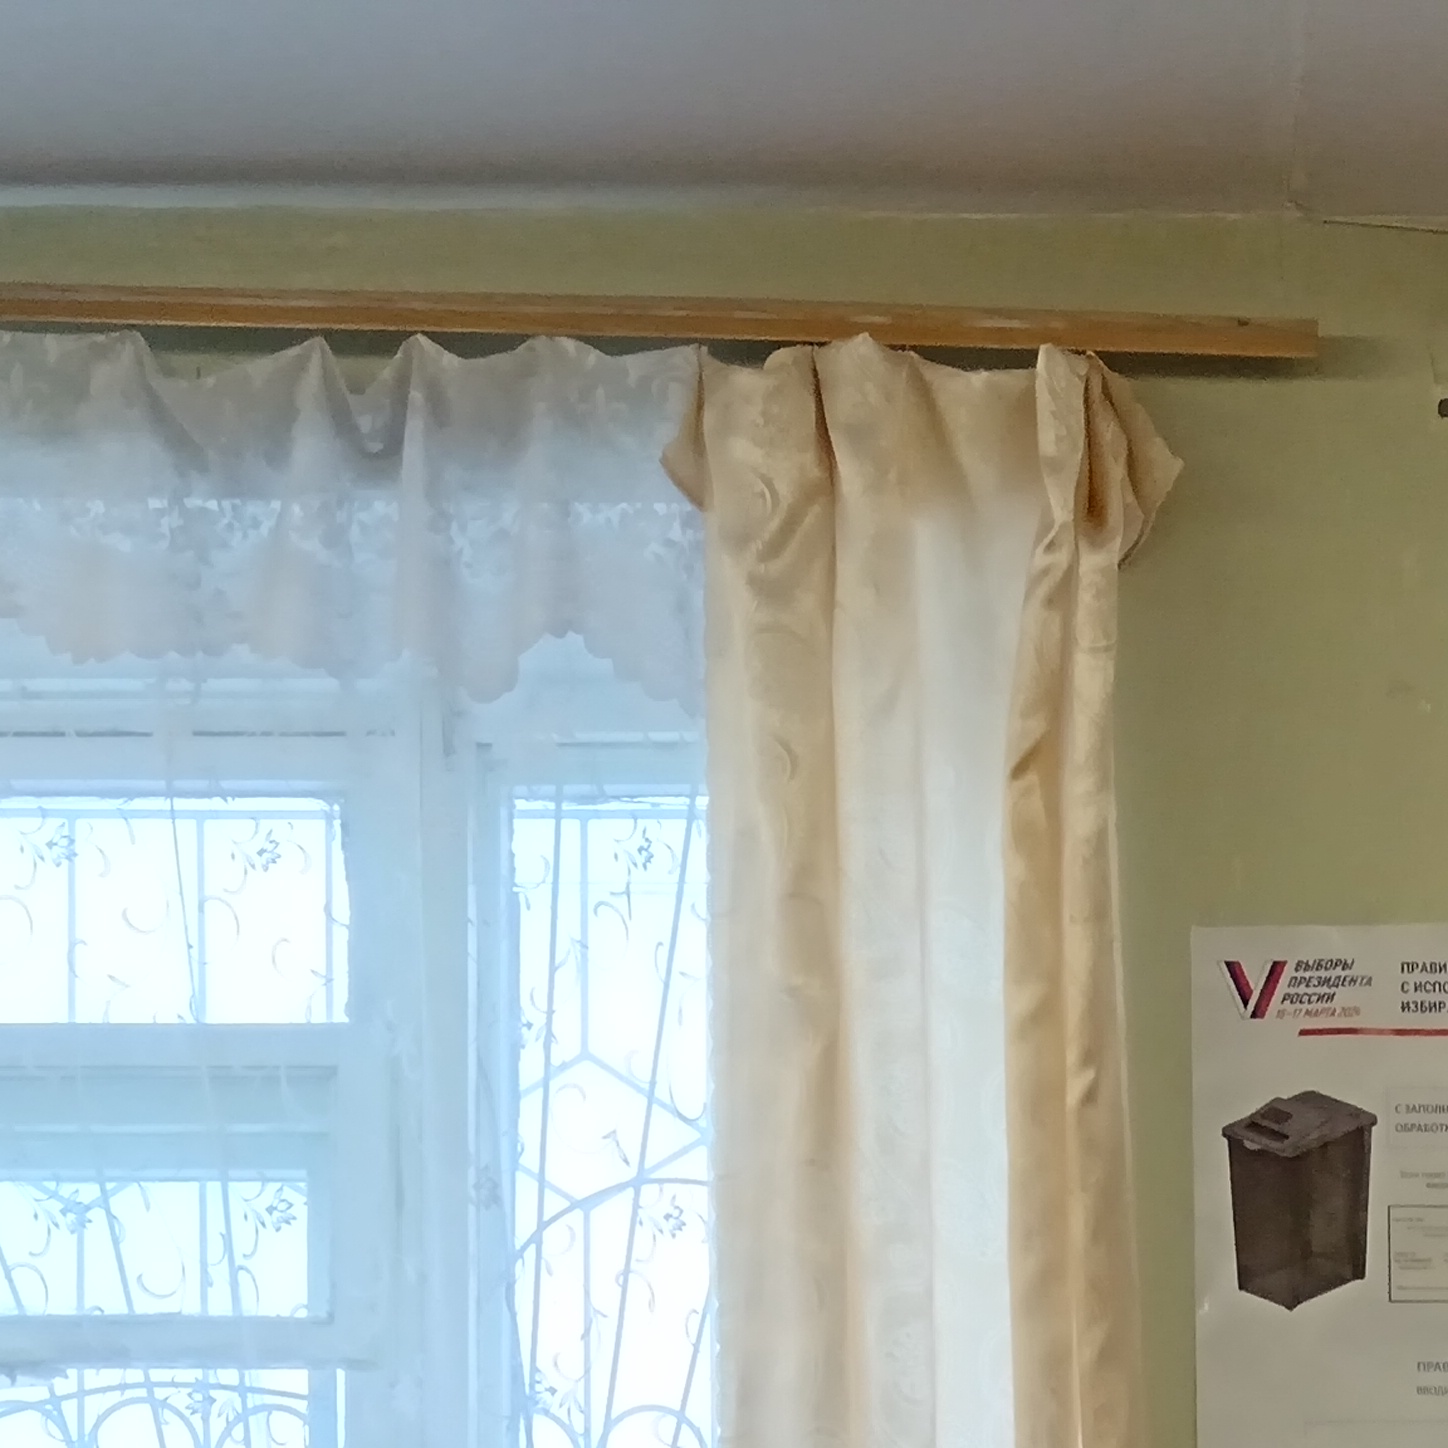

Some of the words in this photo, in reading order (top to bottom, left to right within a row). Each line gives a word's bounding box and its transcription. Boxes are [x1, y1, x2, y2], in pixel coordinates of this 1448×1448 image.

[1294, 958, 1355, 973] ВЫБОРЫ
[1288, 975, 1373, 989] ПРЕЗИДЕНТА
[1400, 981, 1409, 994] С
[1281, 991, 1336, 1005] РОССИИ
